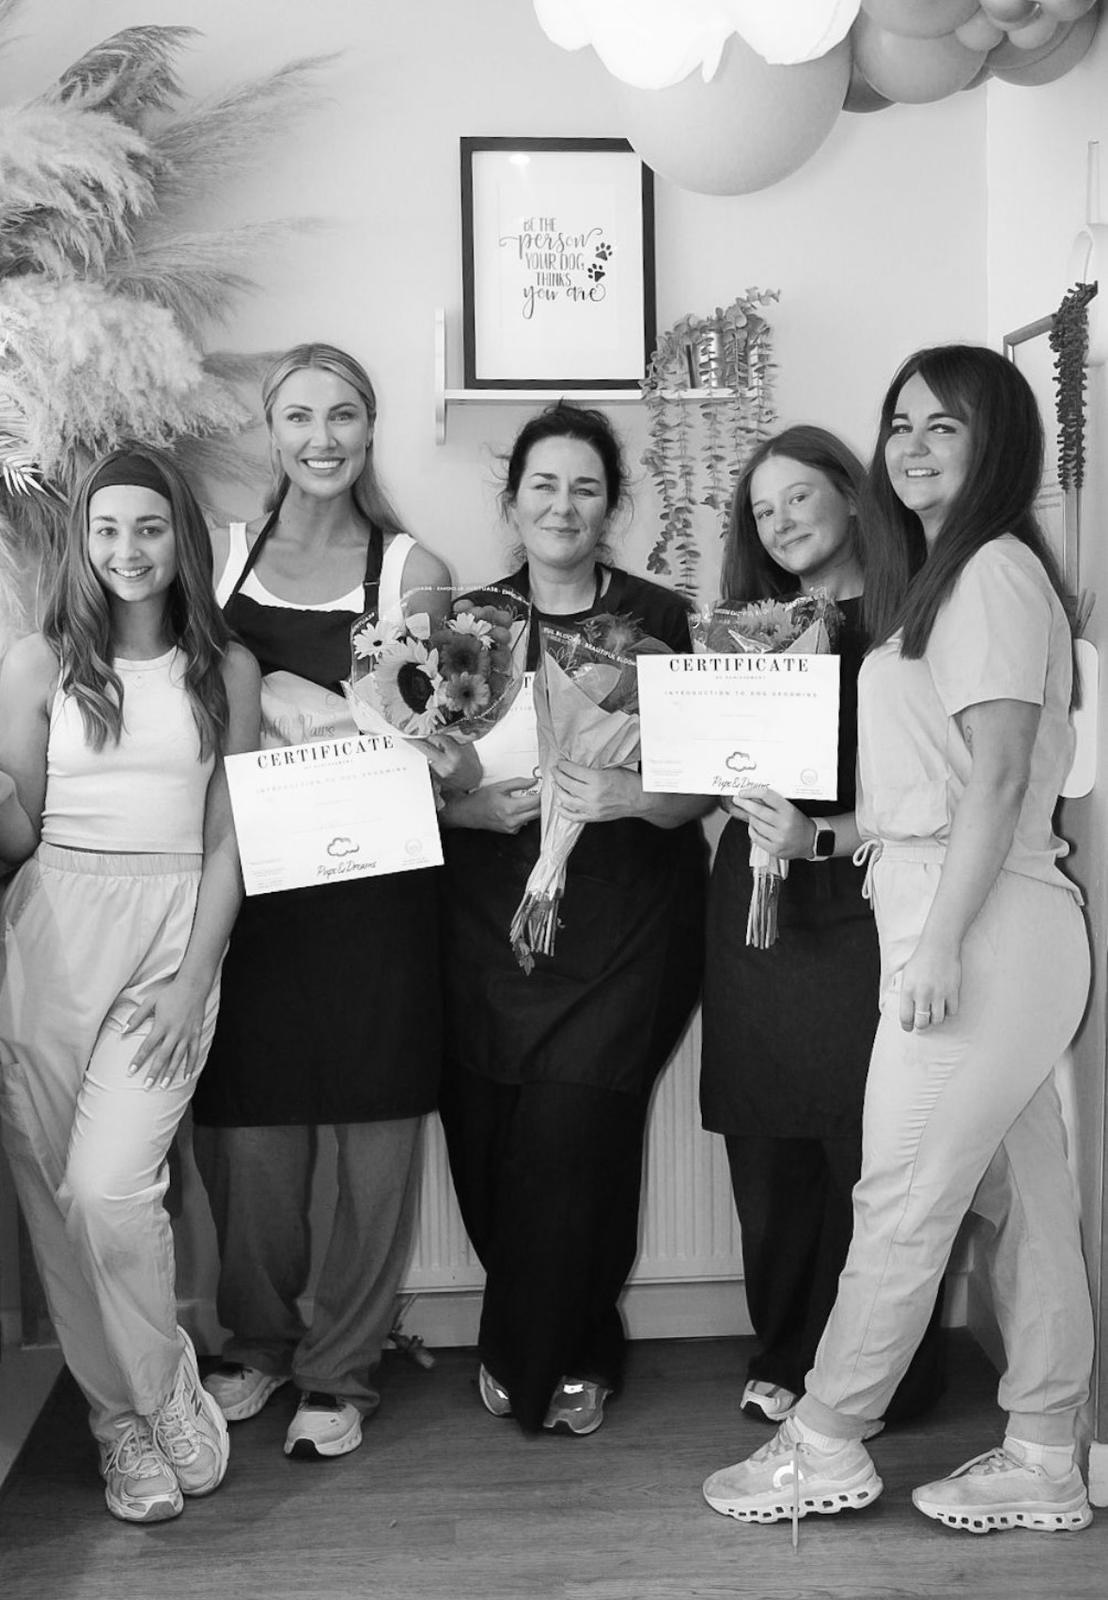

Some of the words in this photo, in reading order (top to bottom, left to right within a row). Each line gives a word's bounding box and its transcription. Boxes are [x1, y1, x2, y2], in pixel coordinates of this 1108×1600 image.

[523, 217, 534, 232] BE
[539, 217, 556, 232] THE
[499, 227, 604, 260] person
[525, 252, 557, 270] YOUR
[559, 252, 585, 270] DOG
[536, 271, 572, 287] THINKS
[522, 285, 558, 320] you
[566, 283, 606, 302] are
[669, 658, 809, 672] CERTIFICATE
[257, 735, 395, 769] CERTIFICATE
